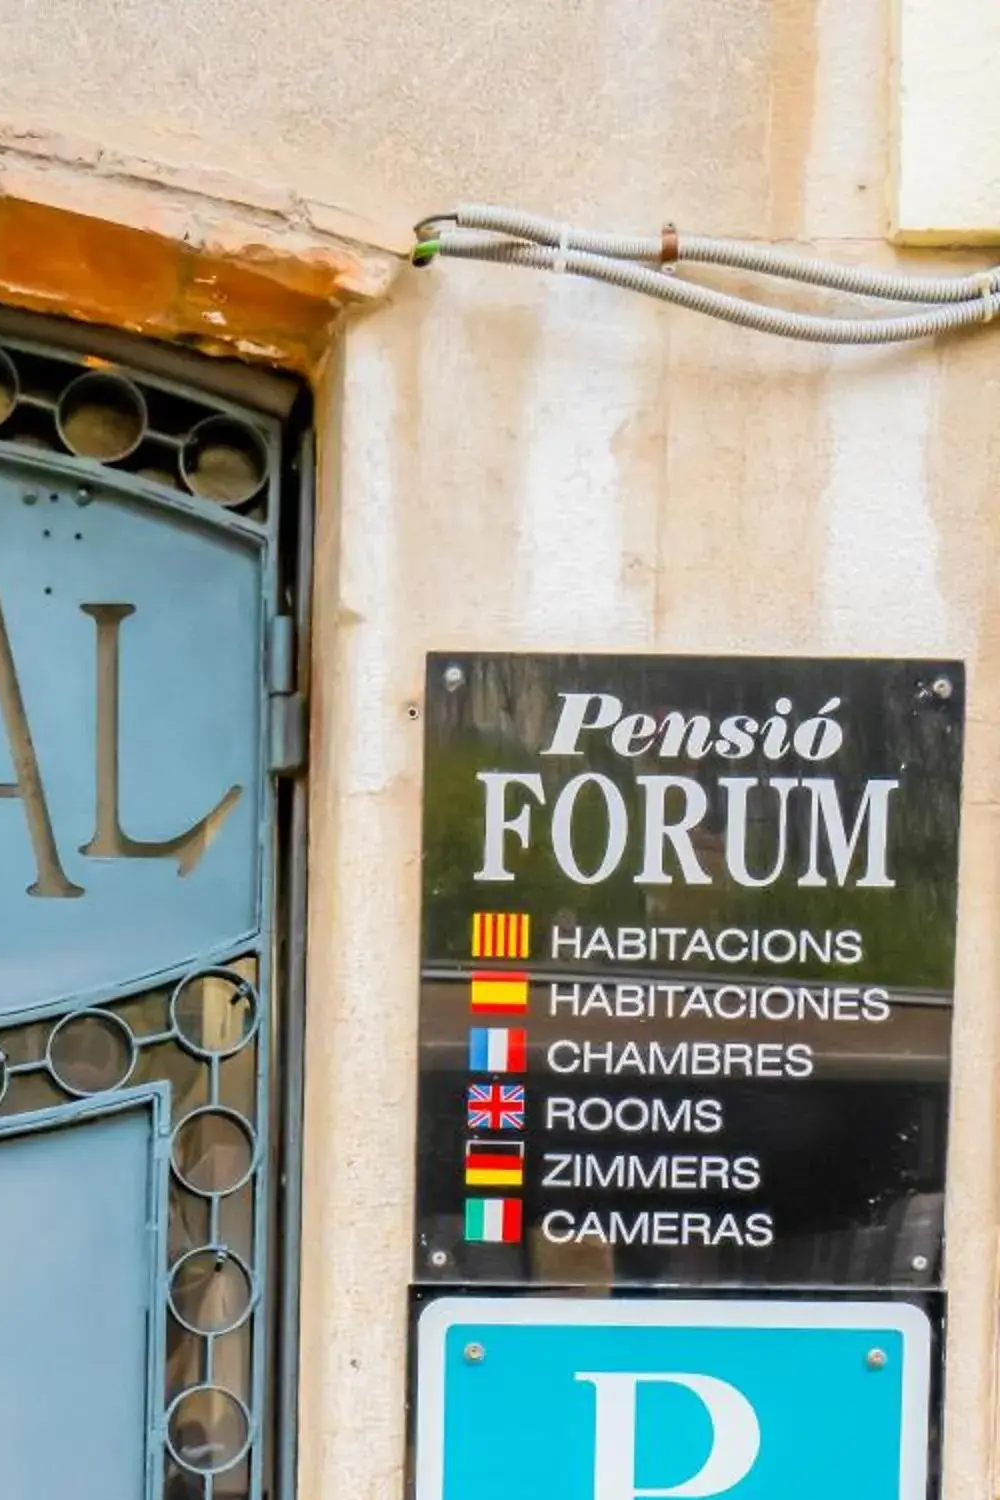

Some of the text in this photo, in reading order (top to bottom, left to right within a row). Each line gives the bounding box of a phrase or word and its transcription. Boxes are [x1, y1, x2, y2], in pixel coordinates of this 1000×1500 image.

[540, 692, 844, 761] Pensió
[473, 772, 900, 888] FORUM
[551, 926, 863, 965] HABITACIONS
[550, 984, 891, 1022] HABITACIONES
[547, 1040, 814, 1078] CHAMBRES
[545, 1098, 723, 1133] ROOMS
[541, 1154, 761, 1190] ZIMMERS
[541, 1210, 774, 1247] CAMERAS
